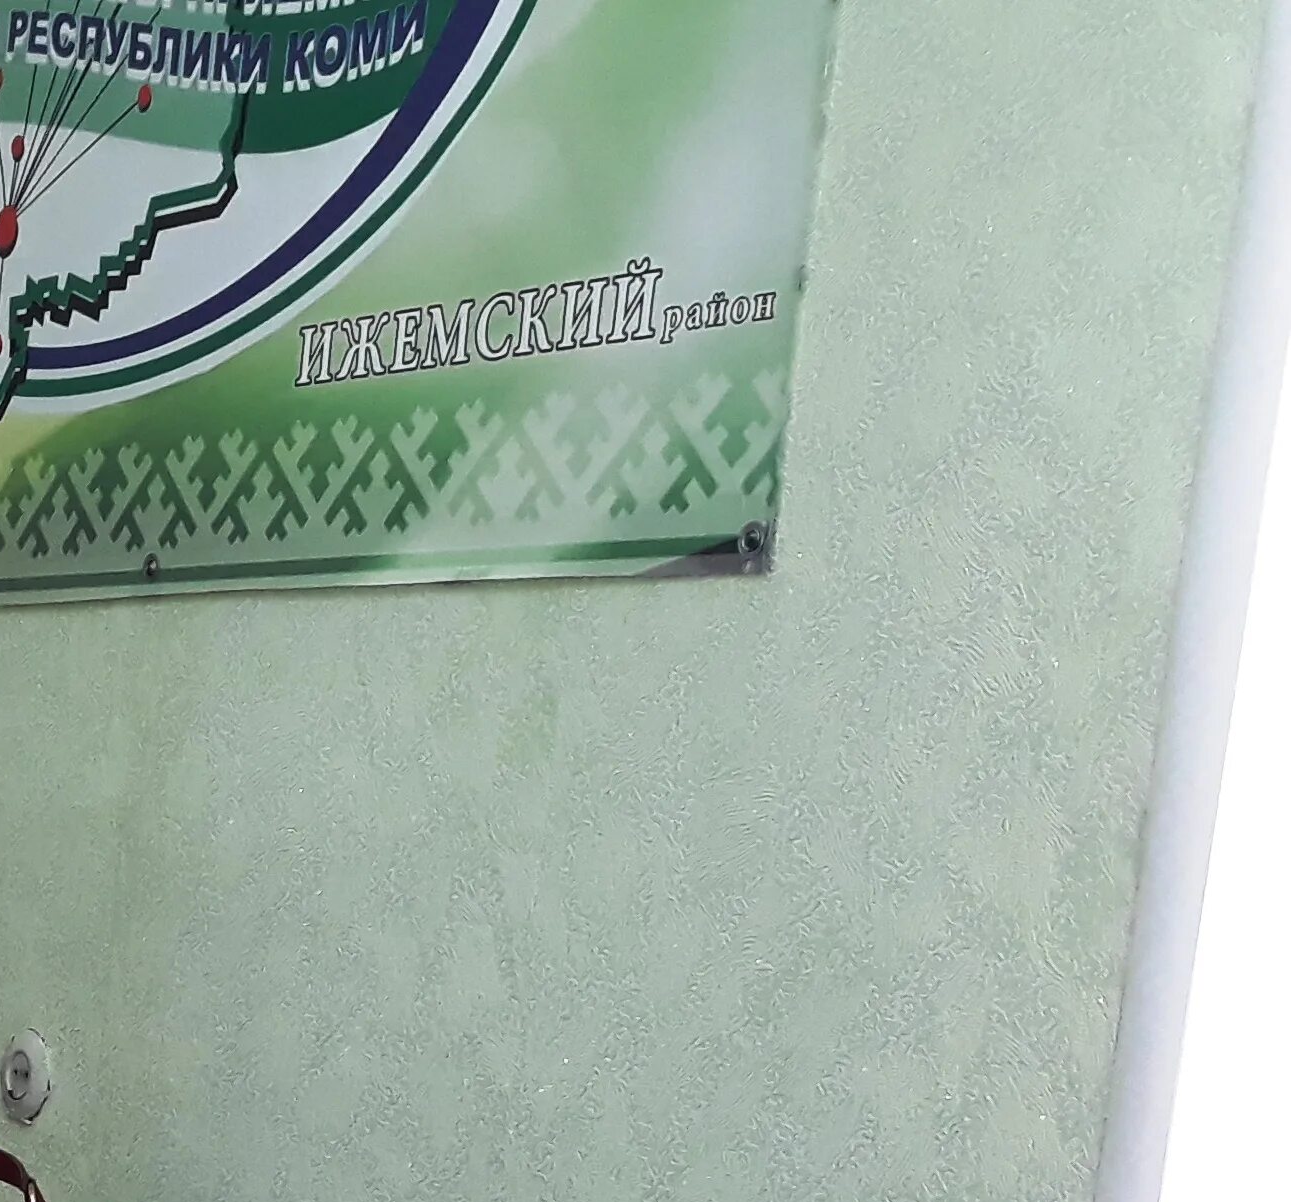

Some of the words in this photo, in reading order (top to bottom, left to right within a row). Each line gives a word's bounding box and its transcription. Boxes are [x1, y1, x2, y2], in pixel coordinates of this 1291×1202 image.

[6, 10, 271, 94] РЕСПУБЛИКИ
[283, 2, 429, 93] КОМИ
[294, 256, 664, 388] ИЖЕМСКИЙ
[660, 292, 777, 345] район
